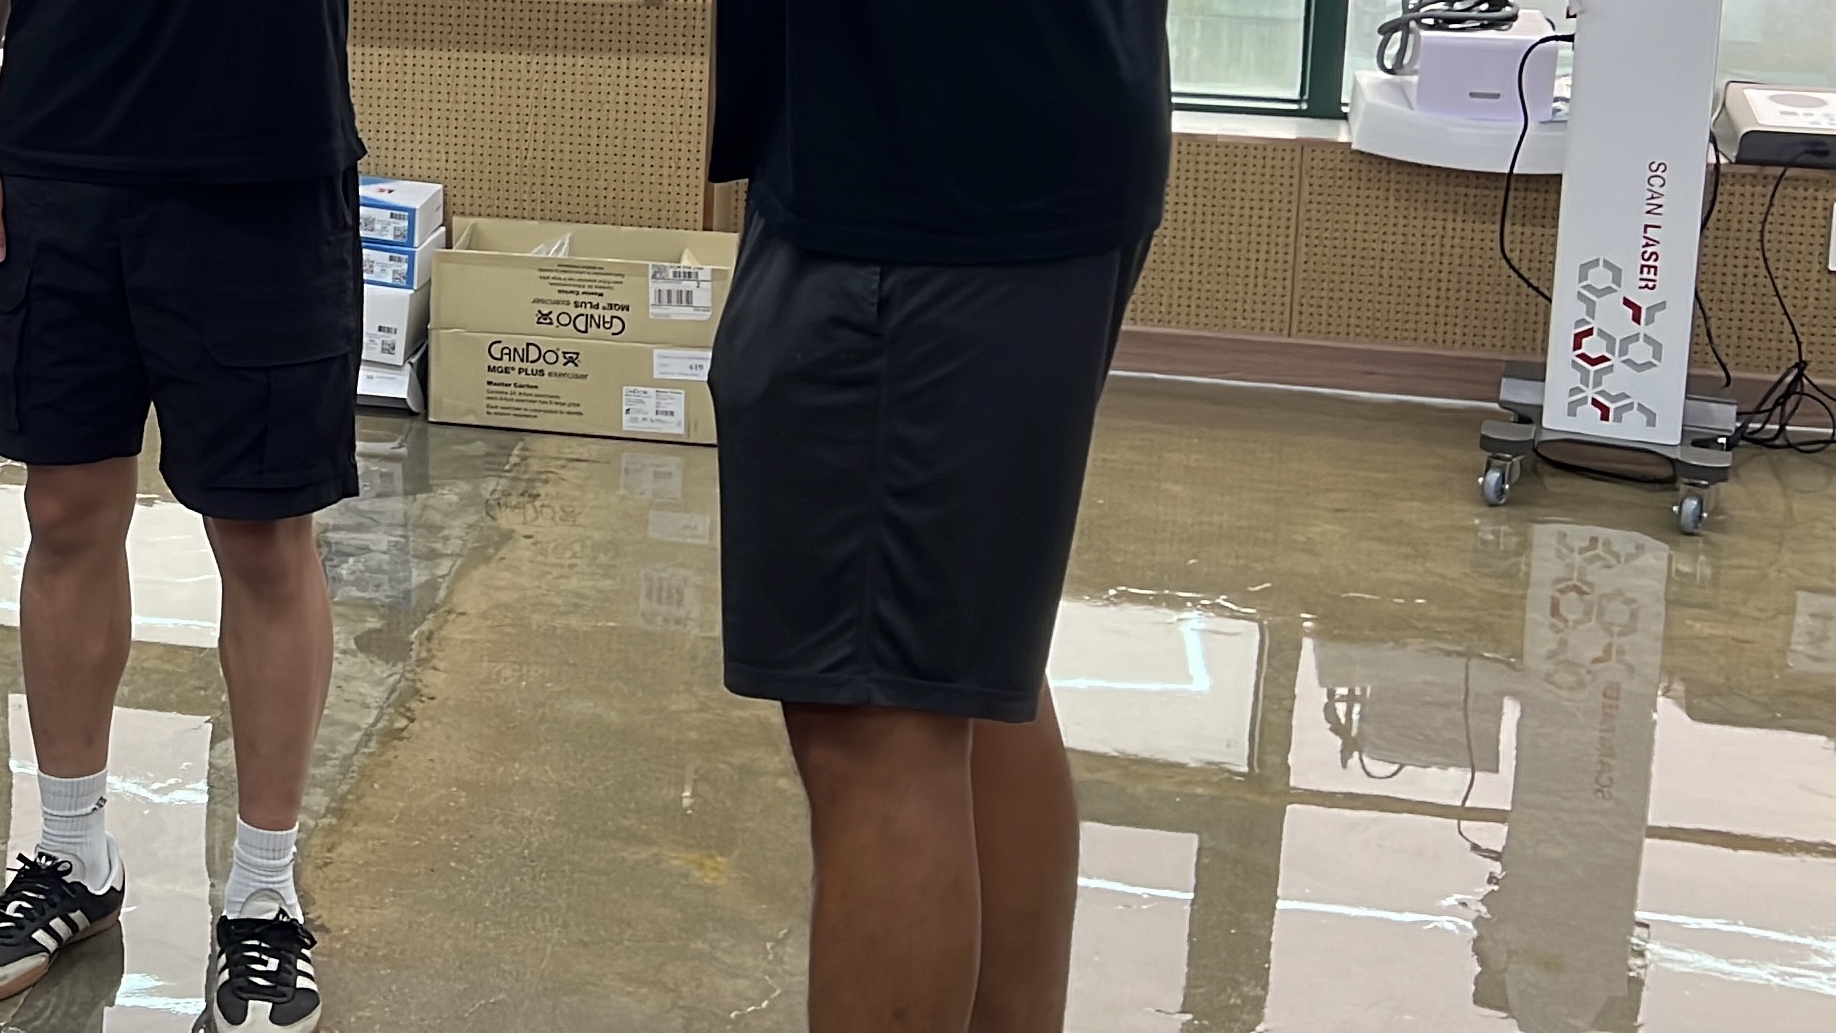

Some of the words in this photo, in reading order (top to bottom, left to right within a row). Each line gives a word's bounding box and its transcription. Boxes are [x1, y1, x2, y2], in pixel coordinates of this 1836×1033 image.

[1644, 160, 1668, 216] SCAN
[1638, 223, 1663, 291] LASER
[573, 300, 600, 310] PLUS
[518, 367, 546, 377] PLUS
